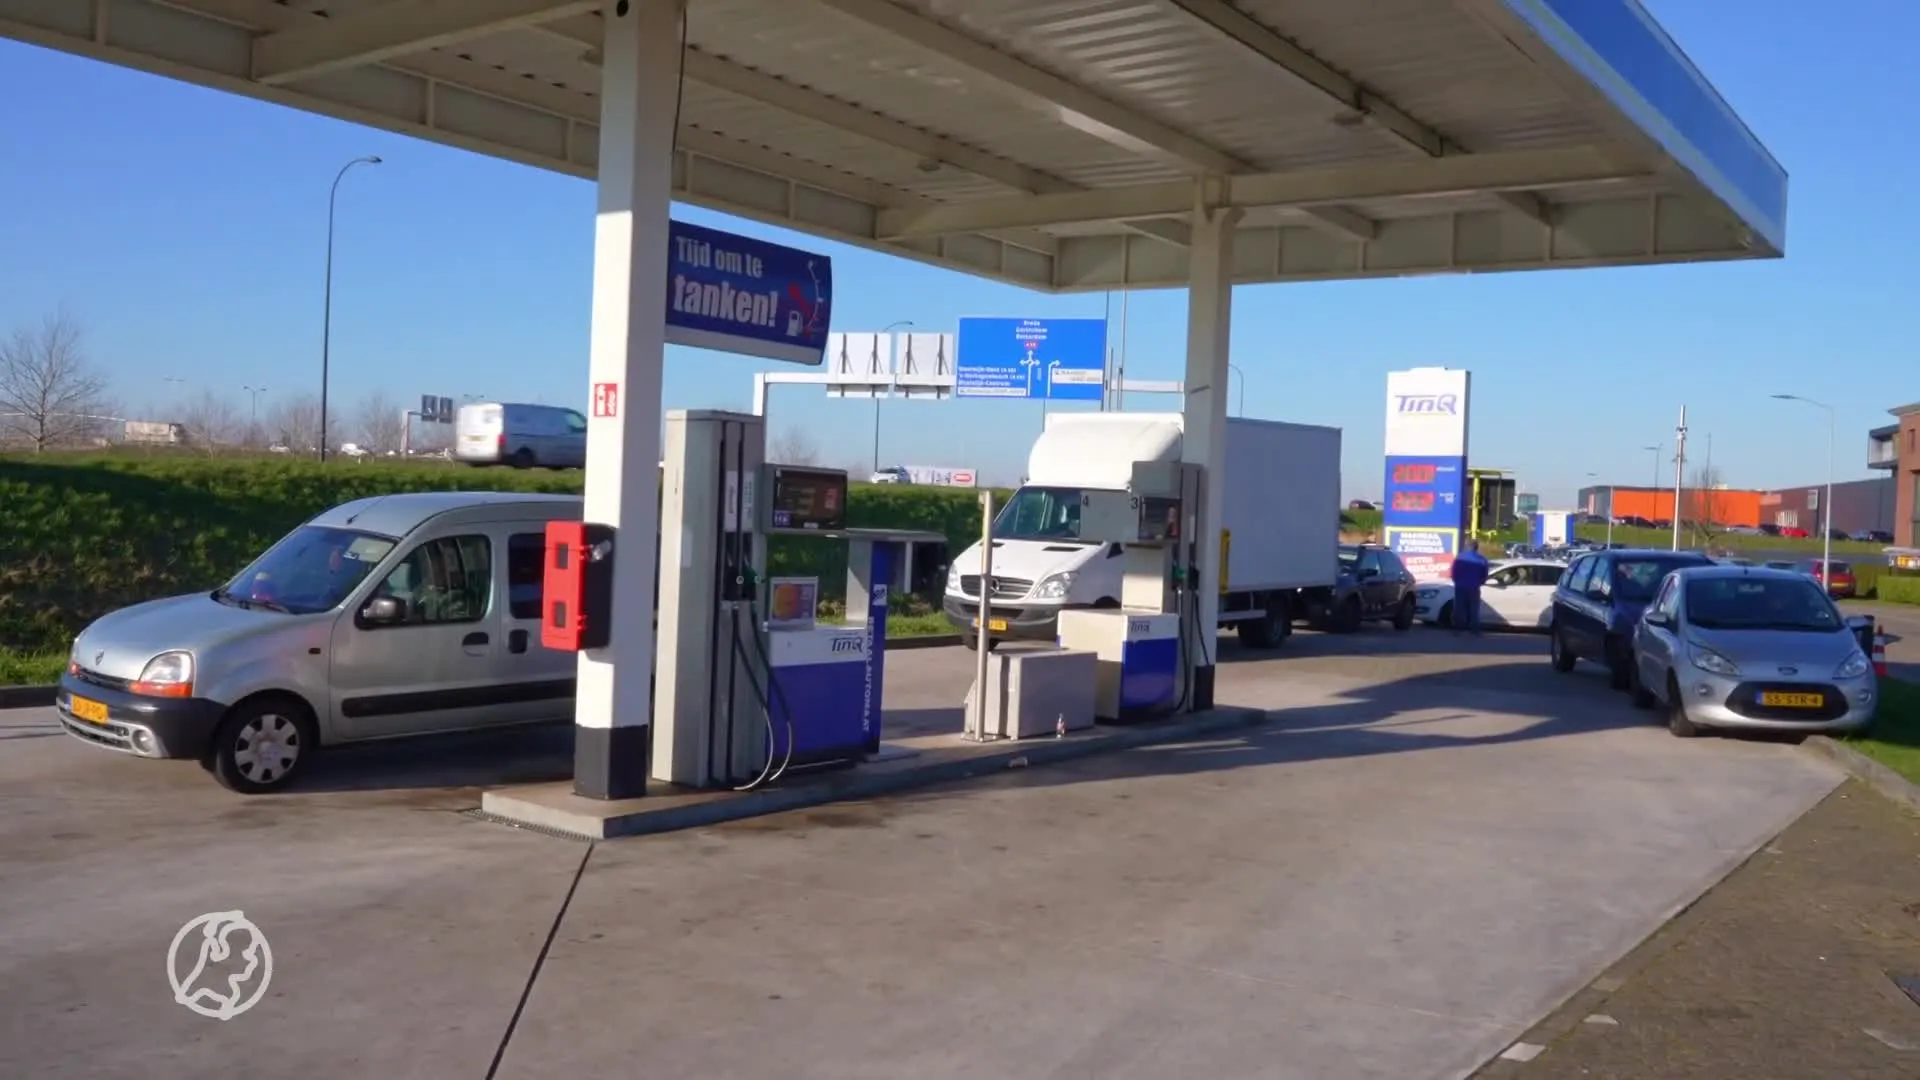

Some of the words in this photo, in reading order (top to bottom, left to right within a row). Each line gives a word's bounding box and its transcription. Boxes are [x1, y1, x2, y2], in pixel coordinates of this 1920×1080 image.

[675, 236, 710, 268] Tijd
[715, 249, 742, 275] om
[745, 254, 763, 278] te
[673, 274, 779, 328] tanken!
[1395, 394, 1457, 415] TinQ
[1082, 494, 1089, 507] 4
[1130, 497, 1139, 509] 3
